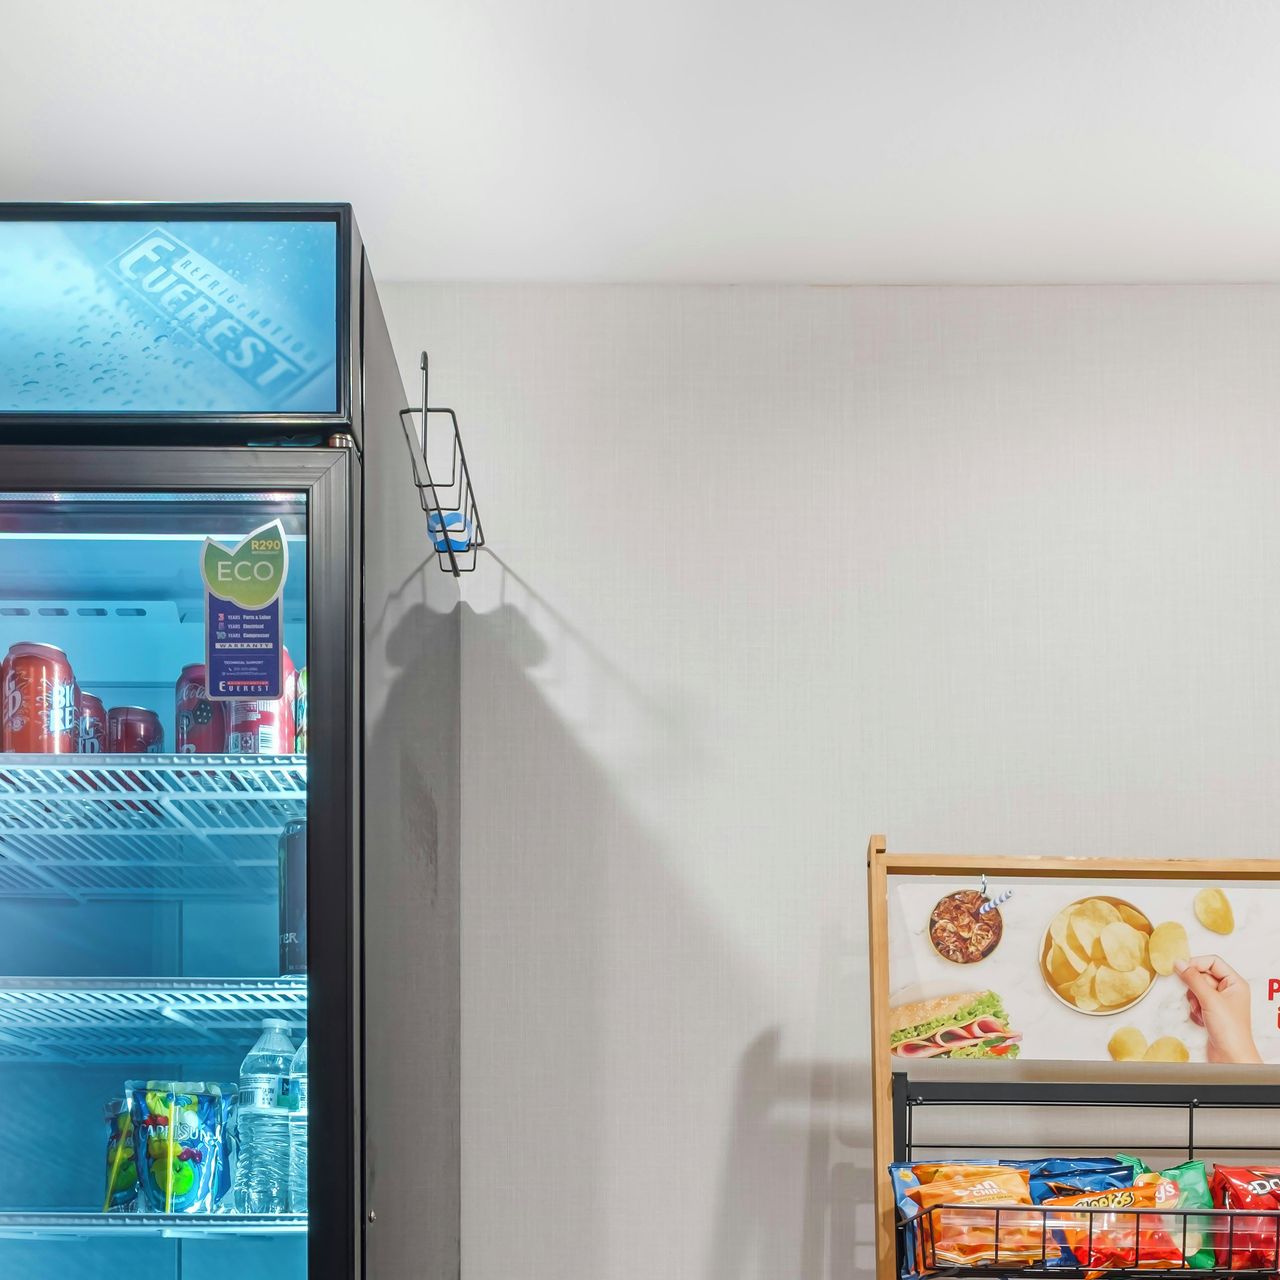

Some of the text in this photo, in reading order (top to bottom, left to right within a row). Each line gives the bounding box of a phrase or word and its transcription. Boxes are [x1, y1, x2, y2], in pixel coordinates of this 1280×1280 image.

[118, 236, 302, 387] EVEREST
[251, 540, 281, 550] R290
[217, 561, 274, 582] ECO
